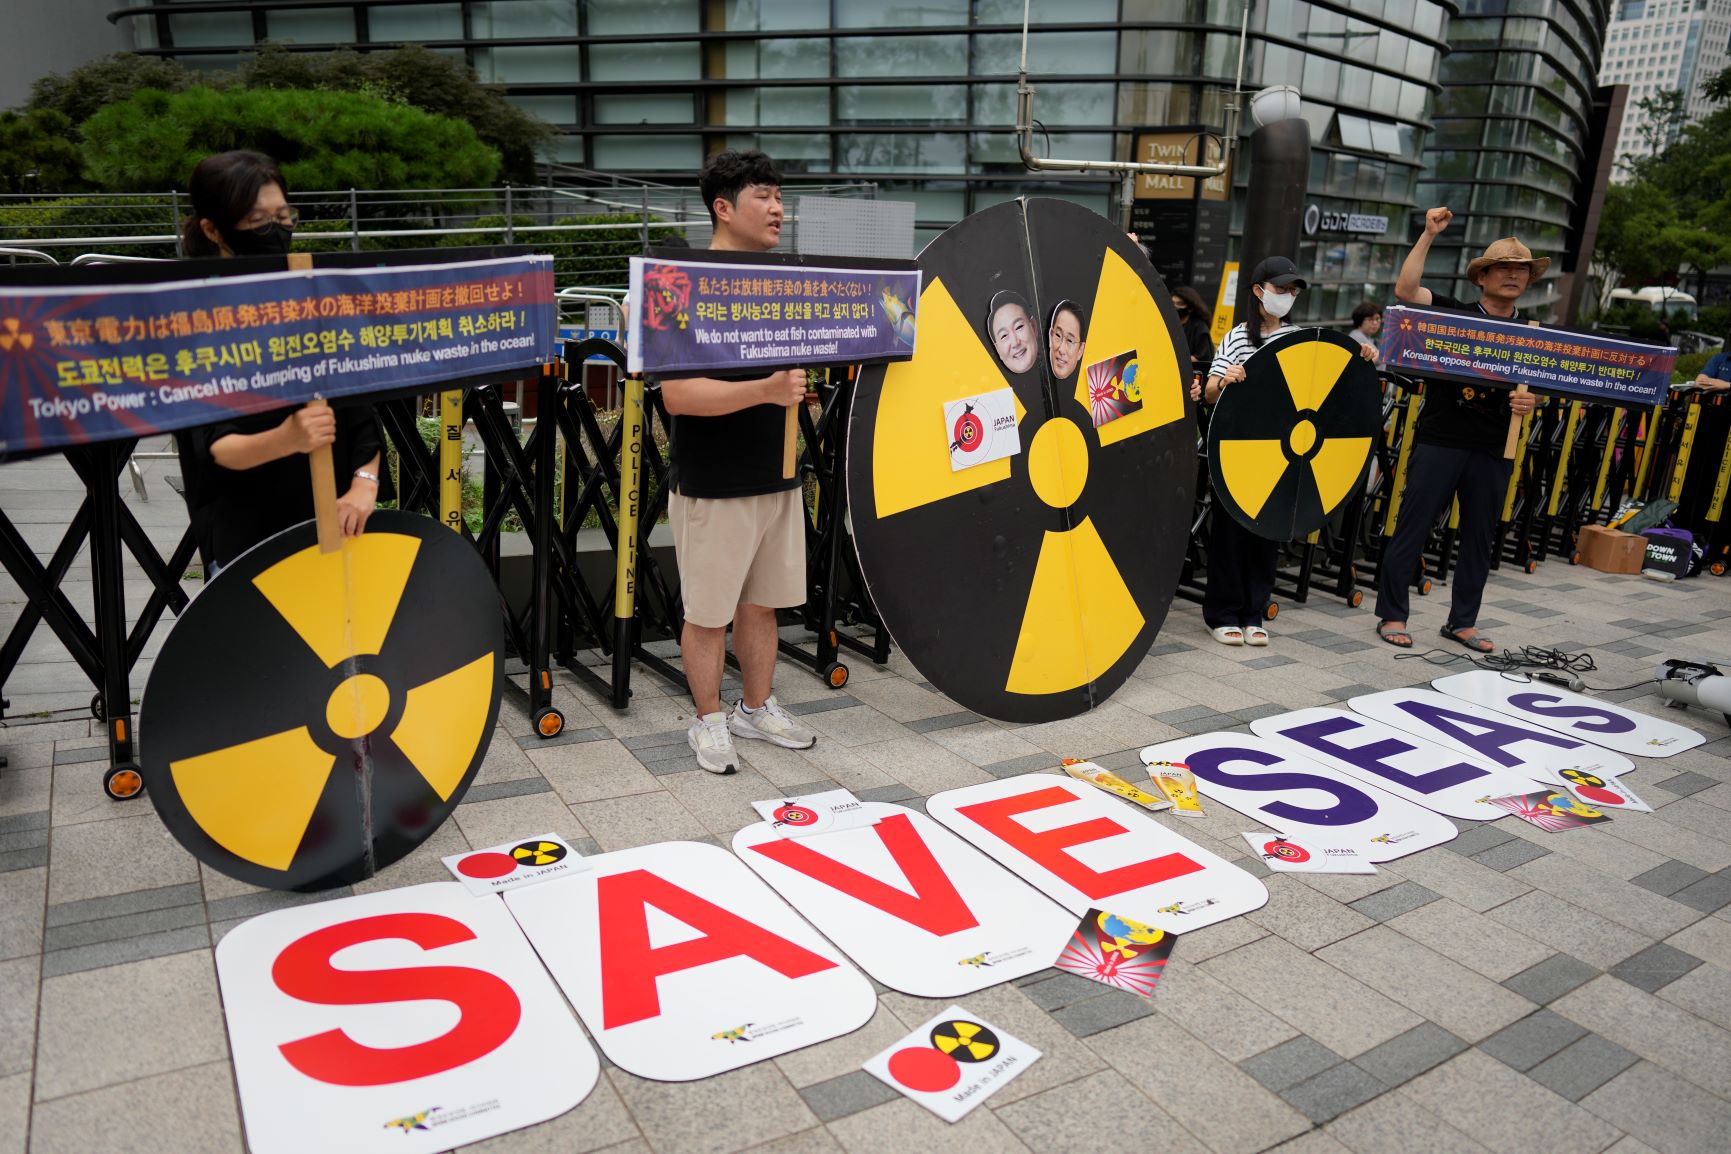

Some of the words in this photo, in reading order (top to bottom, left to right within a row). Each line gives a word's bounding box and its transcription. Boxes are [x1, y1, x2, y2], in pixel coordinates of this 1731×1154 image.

[1145, 174, 1184, 189] MALL
[1321, 212, 1349, 231] GDR
[696, 302, 727, 322] 우리는
[731, 302, 780, 321] 방사능오염
[784, 302, 812, 320] 생선을
[814, 303, 830, 320] 먹고
[833, 303, 849, 320] 싶지
[695, 328, 710, 344] We
[710, 327, 722, 343] do
[724, 328, 740, 343] not
[740, 328, 764, 342] want
[764, 327, 773, 342] to
[774, 327, 789, 342] eat
[790, 326, 806, 340] fish
[808, 326, 859, 340] contaminated
[860, 326, 877, 338] with
[56, 352, 169, 388] 도쿄전력은
[175, 340, 262, 376] 후쿠시마
[268, 329, 355, 362] 원전오염수
[359, 318, 453, 348] 해양투기계획
[458, 313, 516, 337] 취소하라
[740, 344, 790, 359] Fukushima
[790, 342, 812, 356] nuke
[812, 340, 838, 356] waste!
[1425, 337, 1470, 356] 한국국민은
[1472, 343, 1511, 362] 후쿠시마
[1513, 350, 1558, 368] 원전오염수
[1560, 358, 1595, 376] 해양투기
[1598, 364, 1635, 381] 반대한다
[29, 396, 90, 420] Tokyo
[93, 391, 146, 412] Power
[159, 378, 219, 405] Cancel
[221, 374, 248, 394] the
[251, 362, 312, 388] dumping
[313, 359, 328, 378] of
[329, 350, 399, 375] Fukushima
[400, 346, 431, 367] nuke
[432, 343, 470, 361] waste
[470, 342, 480, 355] in
[480, 338, 498, 353] the
[500, 333, 535, 351] ocean!
[1403, 349, 1438, 363] Koreans
[1439, 355, 1471, 369] oppose
[1472, 358, 1510, 376] dumping
[1512, 364, 1557, 381] Fukushima
[1558, 372, 1579, 384] nuke
[1580, 376, 1604, 388] waste
[1604, 377, 1613, 389] in
[1614, 378, 1627, 392] the
[1627, 382, 1656, 396] ocean!
[994, 415, 1014, 427] JAPAN
[628, 424, 640, 517] POLICE
[1646, 544, 1674, 554] DOWN
[1651, 552, 1677, 562] TOWN
[626, 535, 634, 594] LINE
[491, 876, 521, 886] Made
[536, 864, 568, 876] JAPAN
[954, 1084, 982, 1103] Made
[980, 1074, 992, 1086] in
[992, 1055, 1018, 1079] JAPAN
